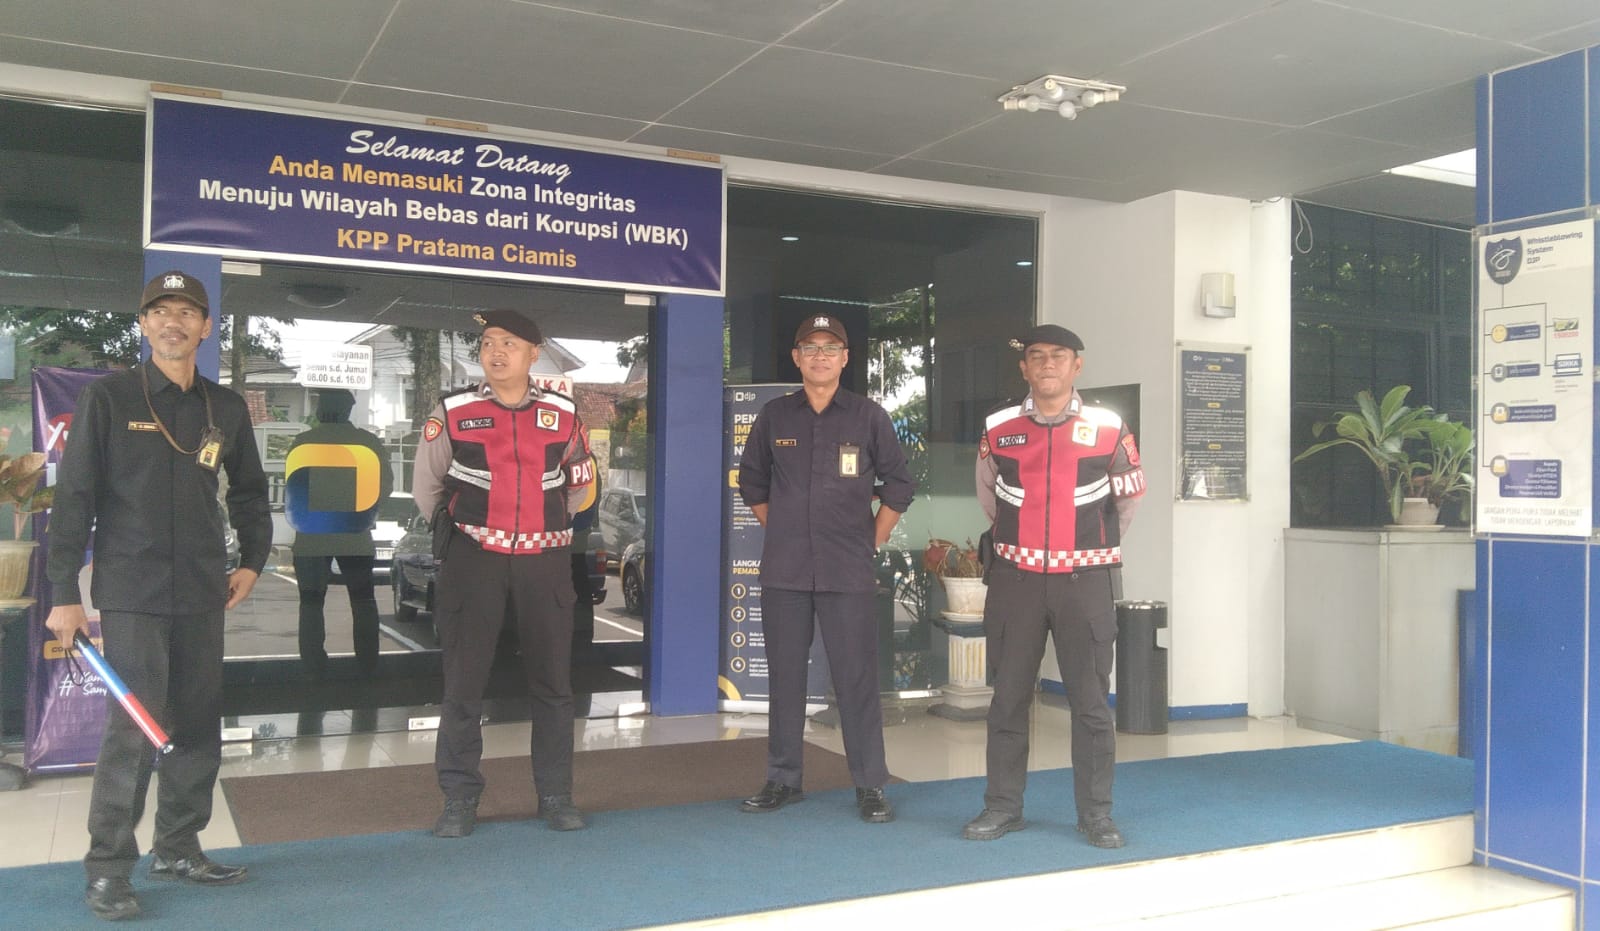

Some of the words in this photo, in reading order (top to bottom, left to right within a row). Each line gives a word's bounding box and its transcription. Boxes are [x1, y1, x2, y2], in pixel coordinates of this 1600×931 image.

[346, 129, 464, 167] Selamat
[475, 144, 572, 181] Datang
[269, 155, 335, 181] Anda
[342, 162, 464, 194] Memasuki
[470, 175, 527, 201] Zona
[534, 181, 637, 214] Integritas
[199, 178, 293, 210] Menuju
[300, 187, 398, 219] Wilayah
[406, 198, 479, 226] Bebas
[485, 206, 529, 231] dari
[535, 210, 619, 241] Korupsi
[624, 221, 689, 250] (WBK)
[1527, 231, 1583, 246] Whistleblowing
[337, 230, 389, 252] KPP
[397, 233, 494, 262] Pratama
[501, 241, 577, 268] Ciamis
[1527, 245, 1554, 256] System
[329, 365, 343, 373] s.d.
[344, 364, 368, 374] Jumat
[307, 373, 328, 383] 08.00
[330, 375, 343, 383] s.d.
[346, 375, 366, 384] 16.00
[735, 610, 742, 618] 2
[735, 635, 742, 643] 3
